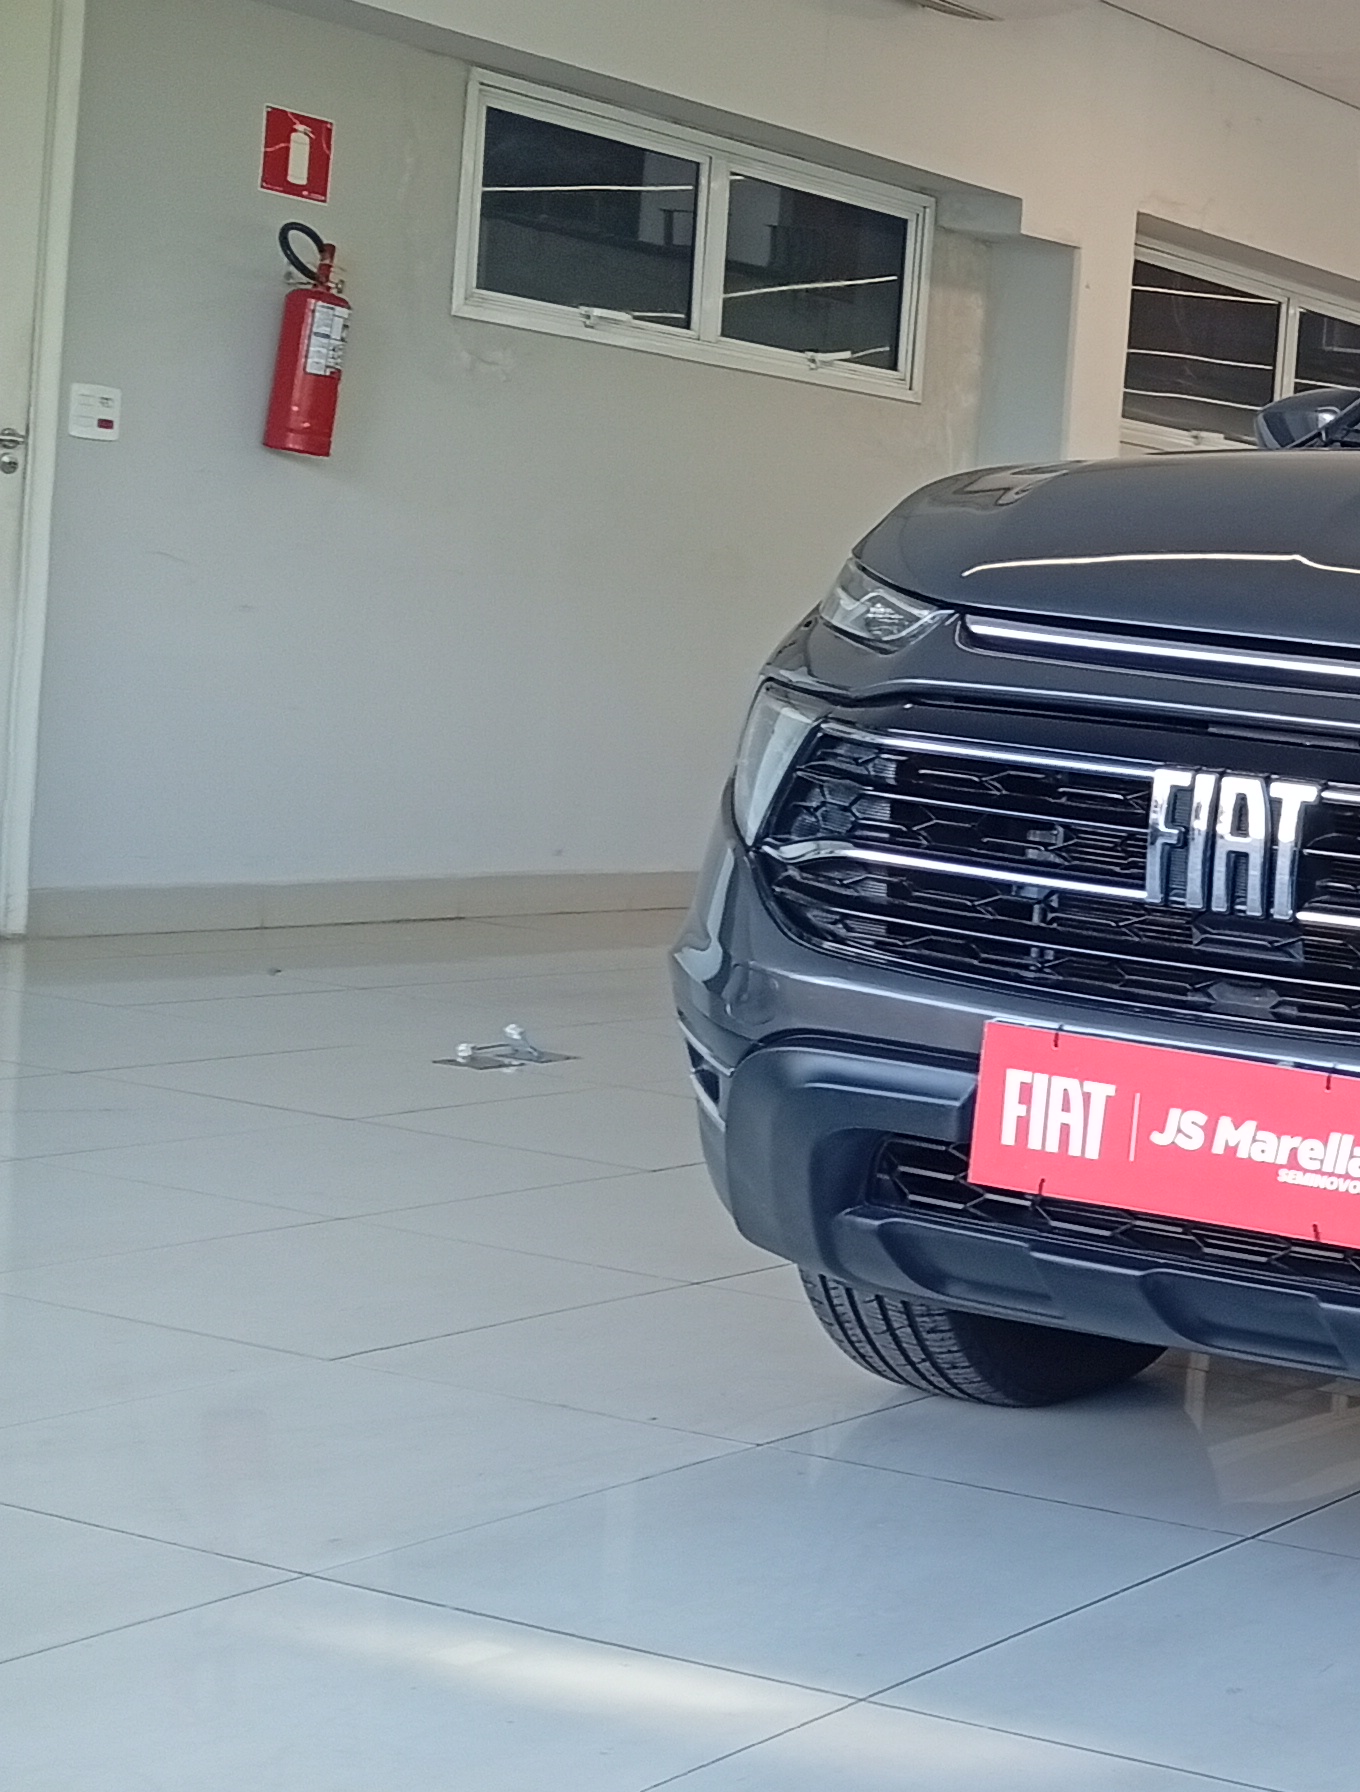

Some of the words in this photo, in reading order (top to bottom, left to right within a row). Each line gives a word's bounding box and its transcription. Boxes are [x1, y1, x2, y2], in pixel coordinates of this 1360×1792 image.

[1146, 768, 1319, 921] FIAT
[1001, 1068, 1116, 1160] FIAT
[1149, 1108, 1208, 1150] JS
